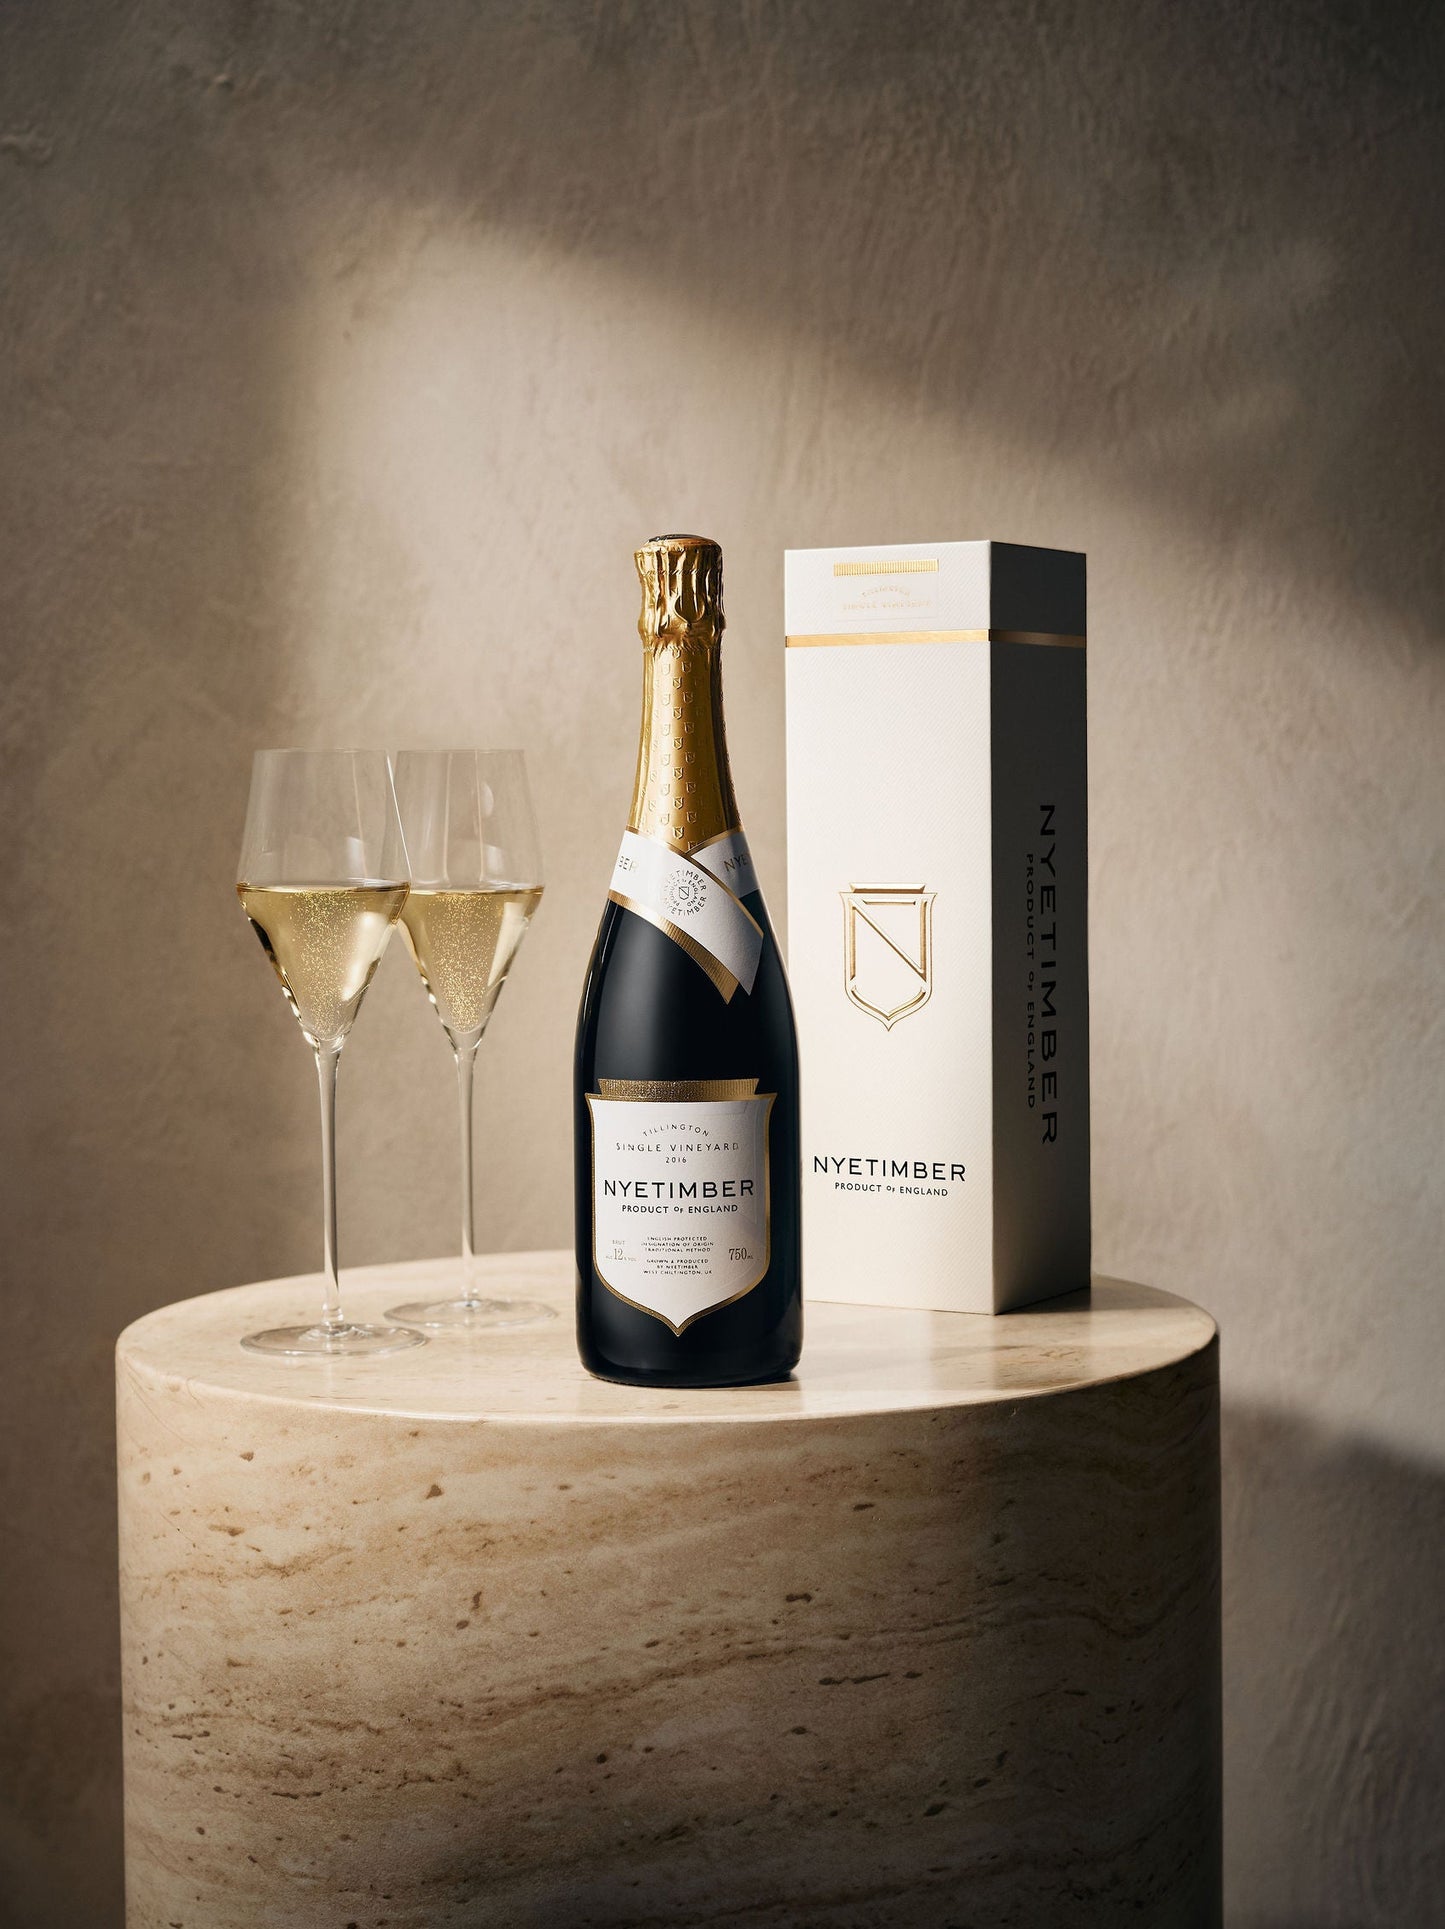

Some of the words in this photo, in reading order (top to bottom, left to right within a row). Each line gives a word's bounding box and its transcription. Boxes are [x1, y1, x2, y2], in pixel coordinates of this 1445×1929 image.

[1026, 854, 1035, 960] PRODUCT
[1039, 804, 1057, 1145] NYETIMBER
[1027, 1002, 1036, 1109] ENGLAND
[642, 1124, 710, 1137] TILLINGTON
[616, 1142, 662, 1152] SINGLE
[670, 1142, 739, 1152] VINEYARD
[814, 1155, 966, 1182] NYETIMBER
[604, 1179, 754, 1199] NYETIMBER
[835, 1182, 882, 1192] PRODUCT
[900, 1186, 948, 1196] ENGLAND
[622, 1204, 668, 1213] PRODUCT
[688, 1204, 738, 1213] ENGLAND
